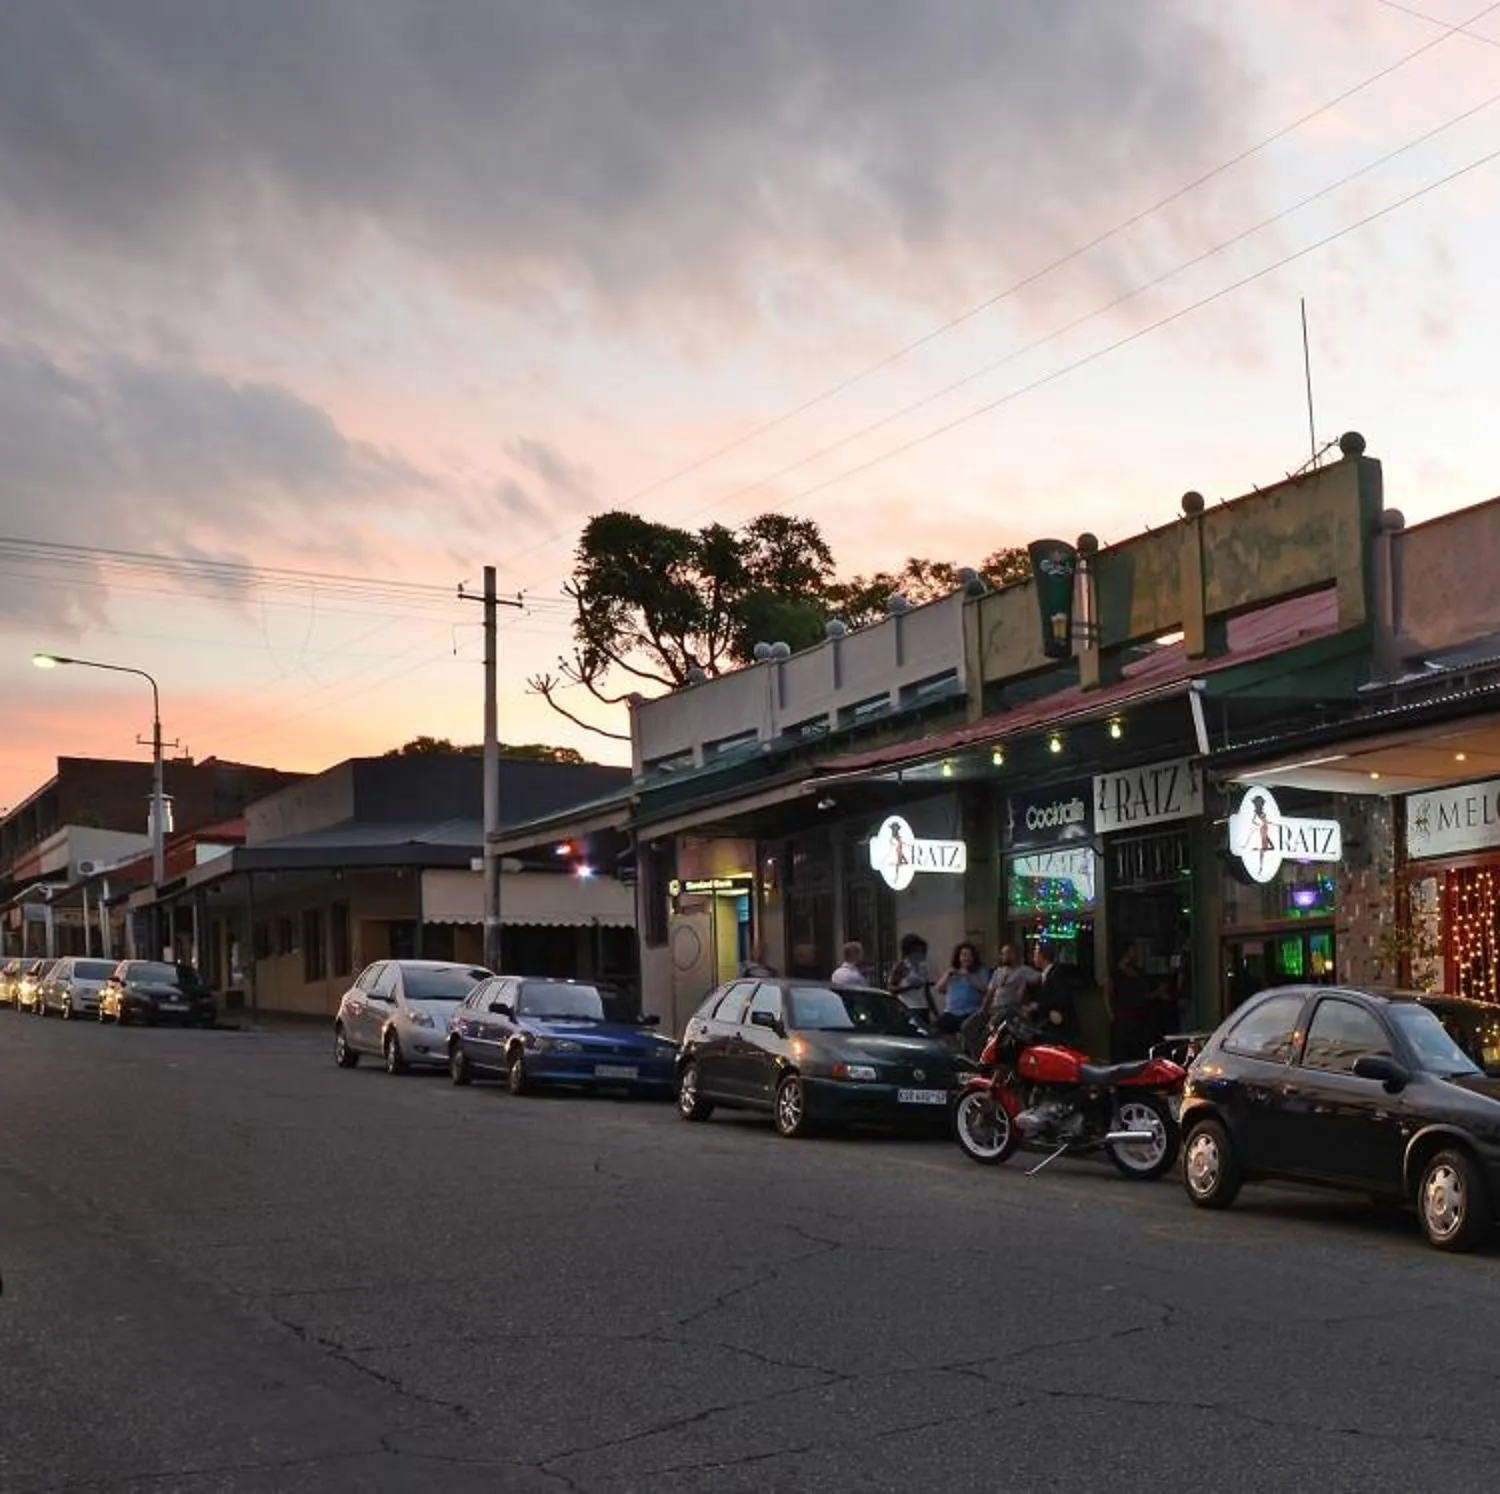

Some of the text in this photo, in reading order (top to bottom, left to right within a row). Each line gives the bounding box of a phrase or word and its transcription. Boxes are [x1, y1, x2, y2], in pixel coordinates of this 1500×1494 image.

[1115, 765, 1181, 823] RATZ
[1277, 823, 1337, 854] RATZ
[908, 844, 961, 868] RATZ
